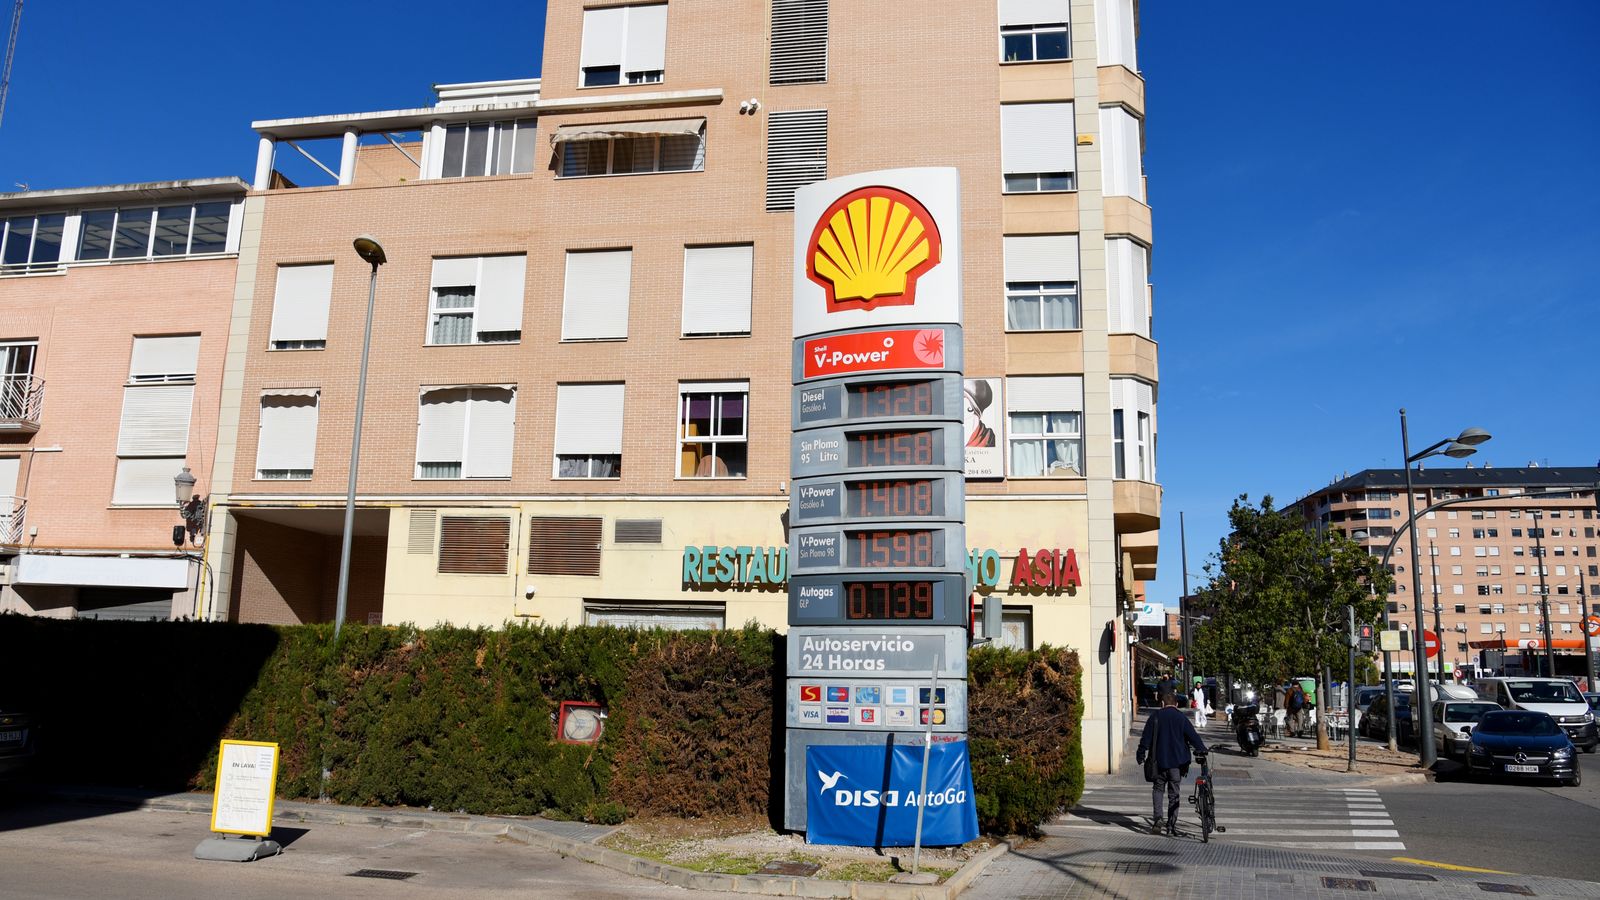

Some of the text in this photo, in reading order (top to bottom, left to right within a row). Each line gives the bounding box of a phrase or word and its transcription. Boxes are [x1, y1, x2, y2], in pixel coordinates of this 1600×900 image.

[814, 350, 890, 368] V-Power
[802, 389, 825, 403] Diesel
[822, 402, 827, 411] A
[801, 439, 839, 452] Sin Plomo
[801, 451, 839, 464] 95 Litro
[800, 487, 835, 498] V-Power
[820, 499, 825, 508] A
[800, 537, 835, 547] V-Power
[800, 547, 835, 558] Sin Plomo 98
[683, 545, 790, 584] RESTAU
[1013, 547, 1082, 587] ASIA
[800, 587, 834, 599] Autogas
[849, 582, 932, 618] 0.739
[803, 635, 915, 652] Autoservicio
[803, 654, 885, 671] 24 Horas
[803, 710, 819, 719] VISA
[904, 788, 966, 807] AutoGa
